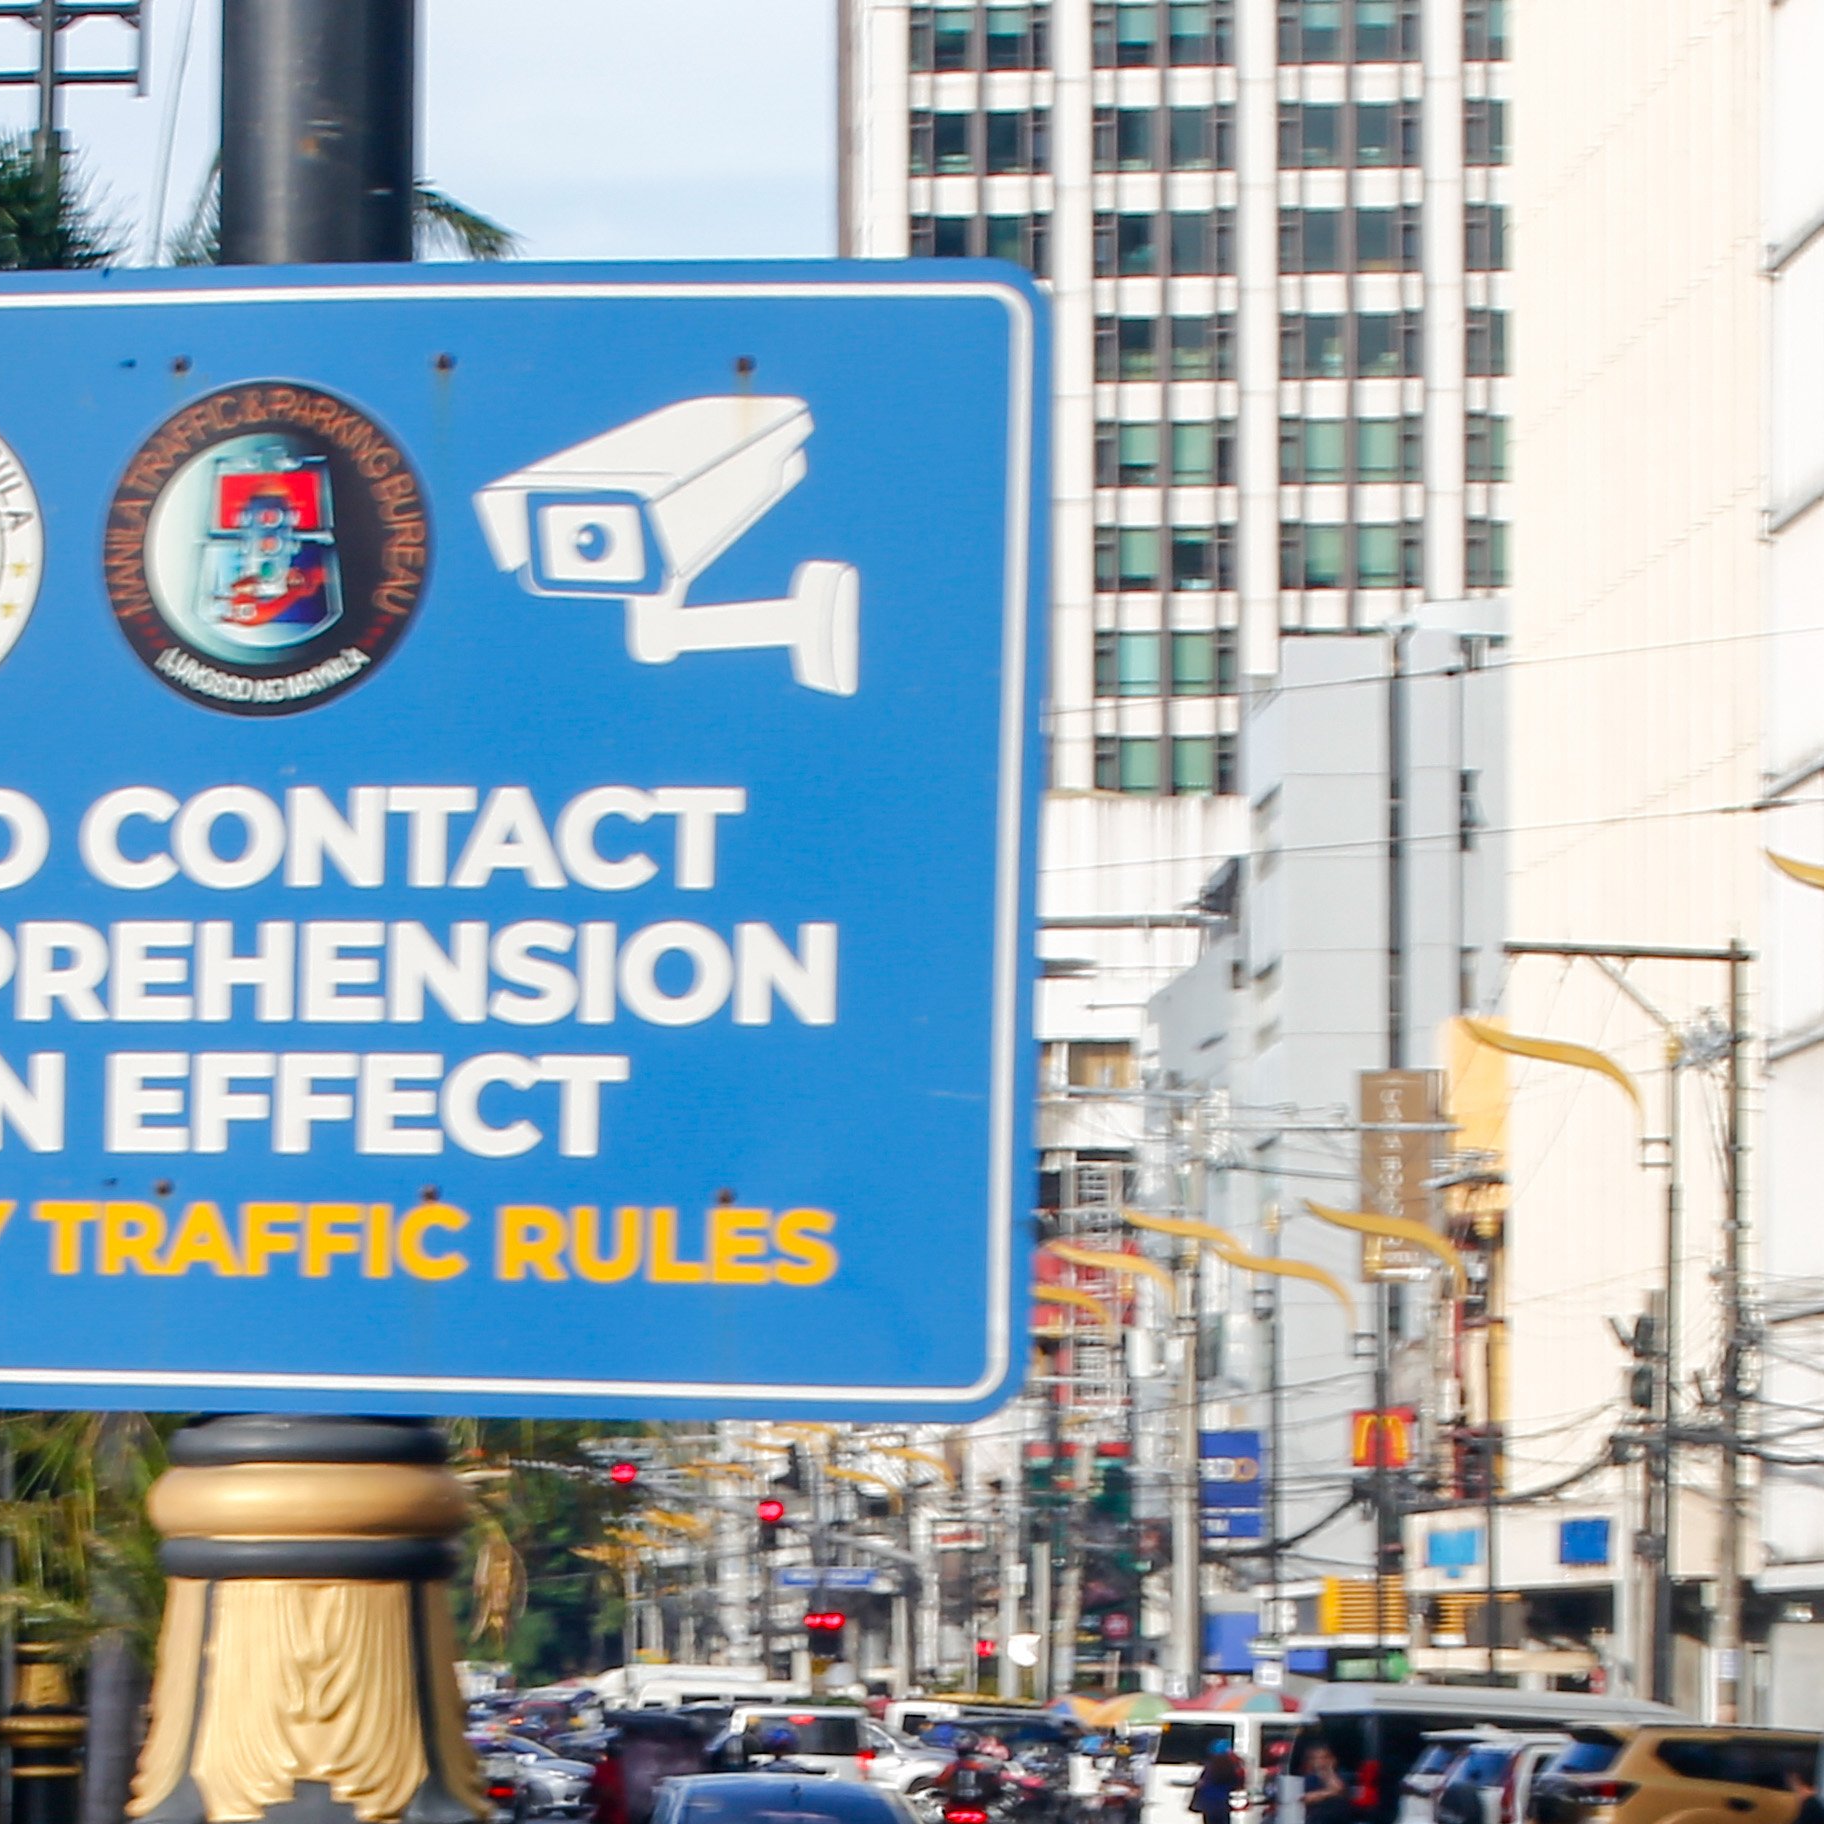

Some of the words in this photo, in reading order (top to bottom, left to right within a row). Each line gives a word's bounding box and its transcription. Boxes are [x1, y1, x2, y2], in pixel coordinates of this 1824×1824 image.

[128, 394, 241, 494] TRAFFIC
[269, 388, 401, 478] PARKING
[372, 472, 426, 615] BUREAU
[78, 784, 747, 891] CONTACT
[104, 1050, 630, 1157] EFFECT
[37, 1201, 468, 1282] TRAFFIC
[501, 1206, 838, 1286] RULES
